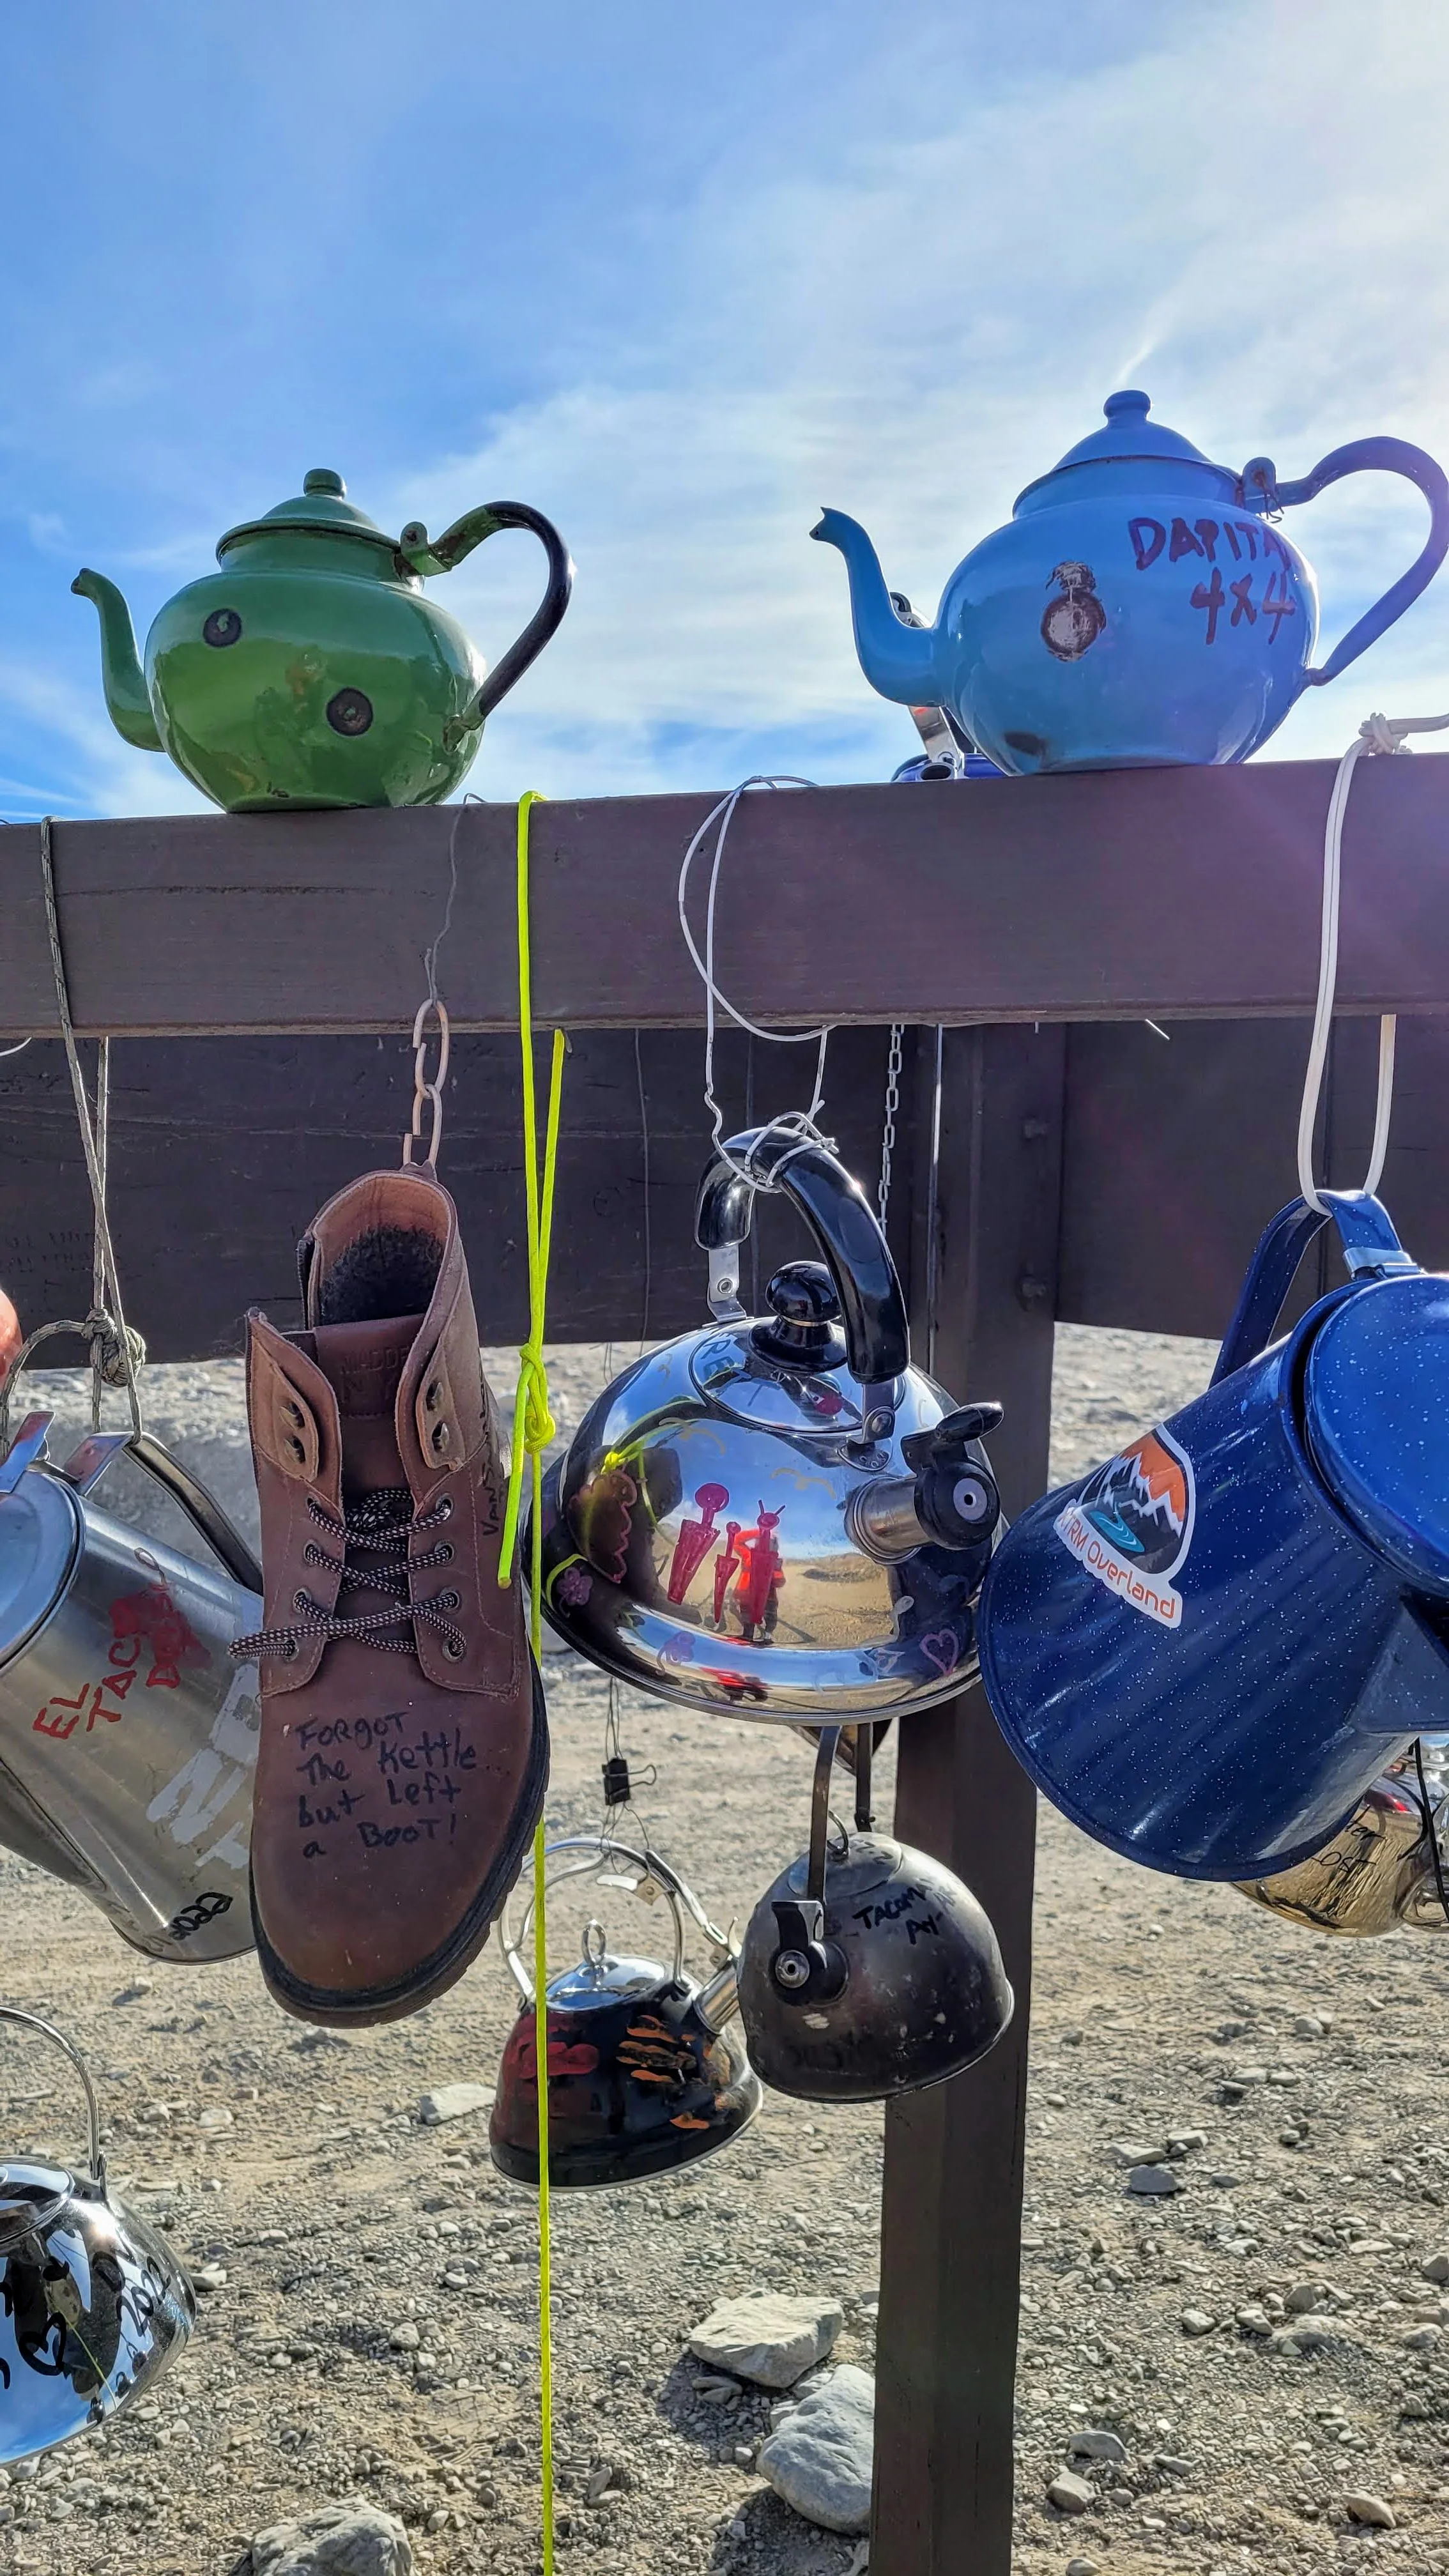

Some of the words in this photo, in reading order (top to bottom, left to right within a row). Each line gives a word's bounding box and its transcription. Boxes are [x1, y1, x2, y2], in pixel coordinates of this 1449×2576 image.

[1087, 1541, 1175, 1620] Overland
[33, 1683, 90, 1739] EL
[296, 1752, 349, 1786] The
[299, 1789, 365, 1828] but
